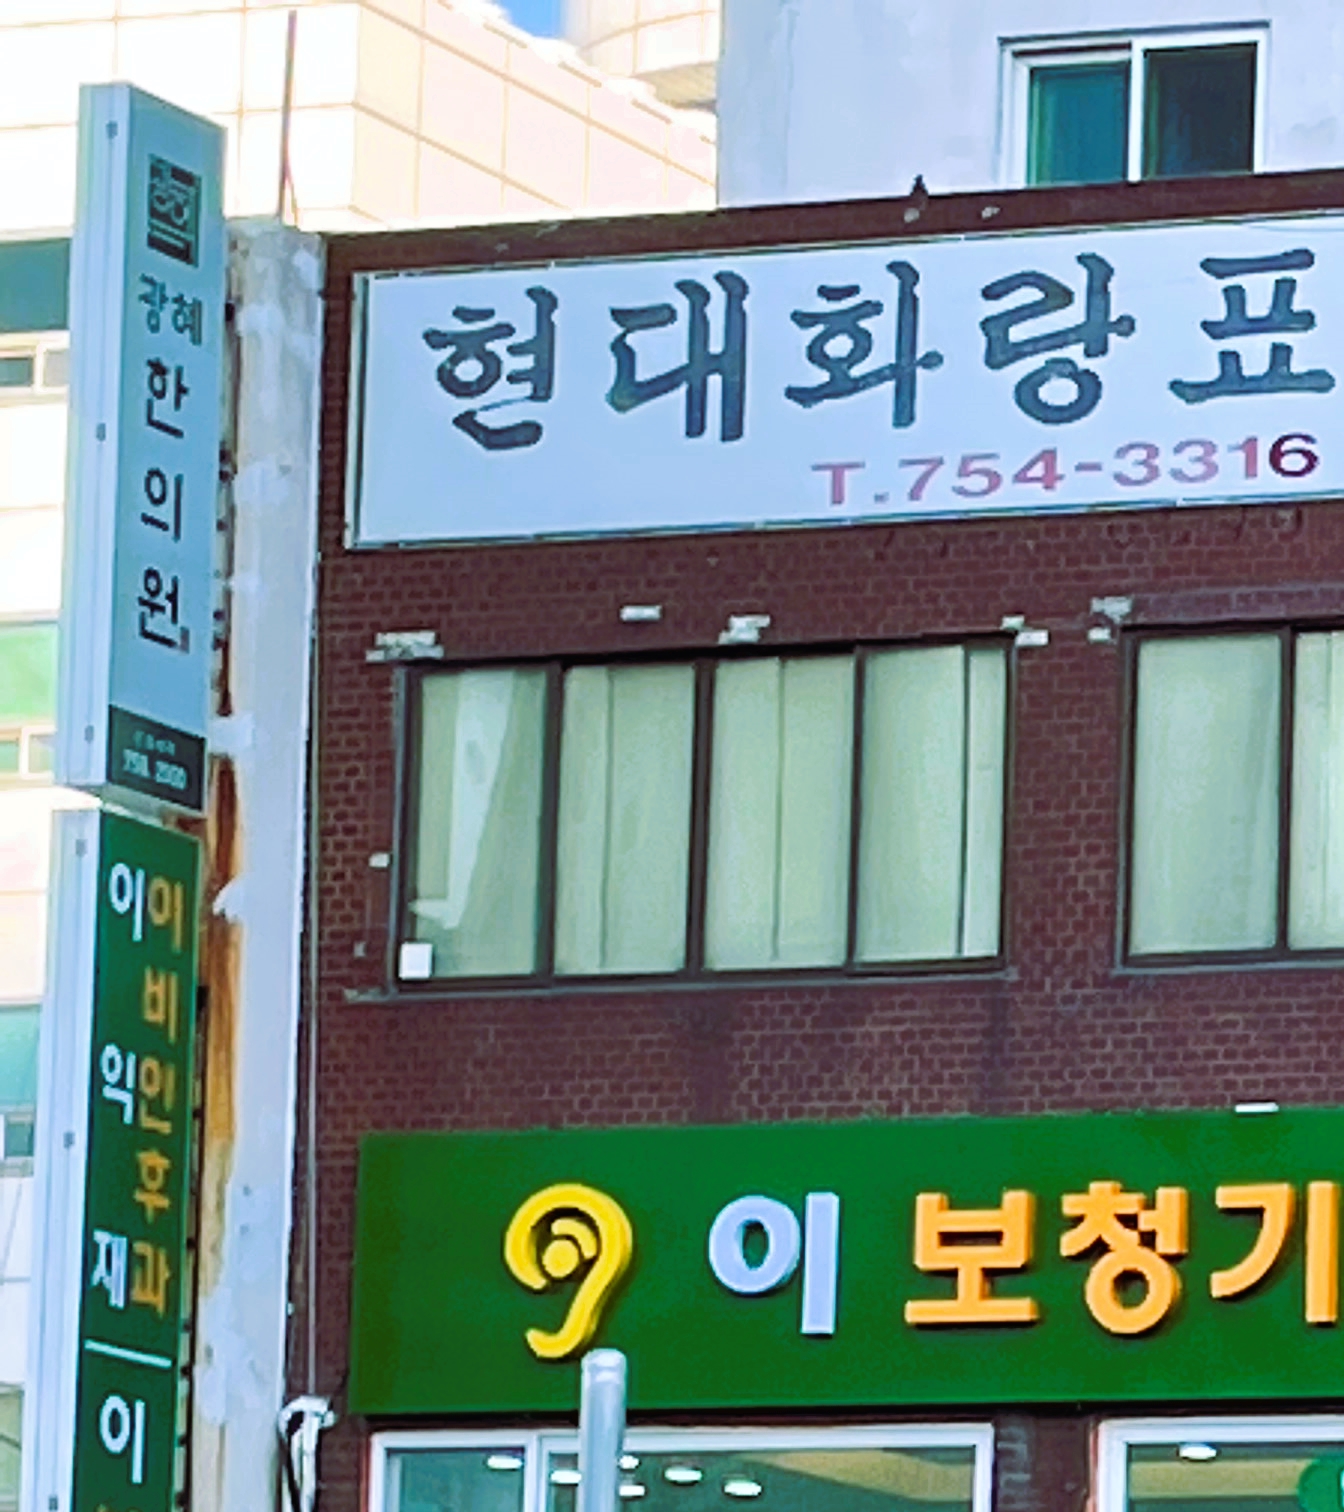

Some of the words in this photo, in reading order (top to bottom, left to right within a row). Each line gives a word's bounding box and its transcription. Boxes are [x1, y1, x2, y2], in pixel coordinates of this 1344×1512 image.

[139, 355, 190, 655] 한의원
[812, 432, 1321, 508] T.754-3316
[91, 862, 144, 1310] 이익재
[130, 874, 184, 1318] 이비인후과
[707, 1190, 838, 1336] 이
[905, 1179, 1342, 1336] 보청기
[100, 1395, 146, 1485] 이
